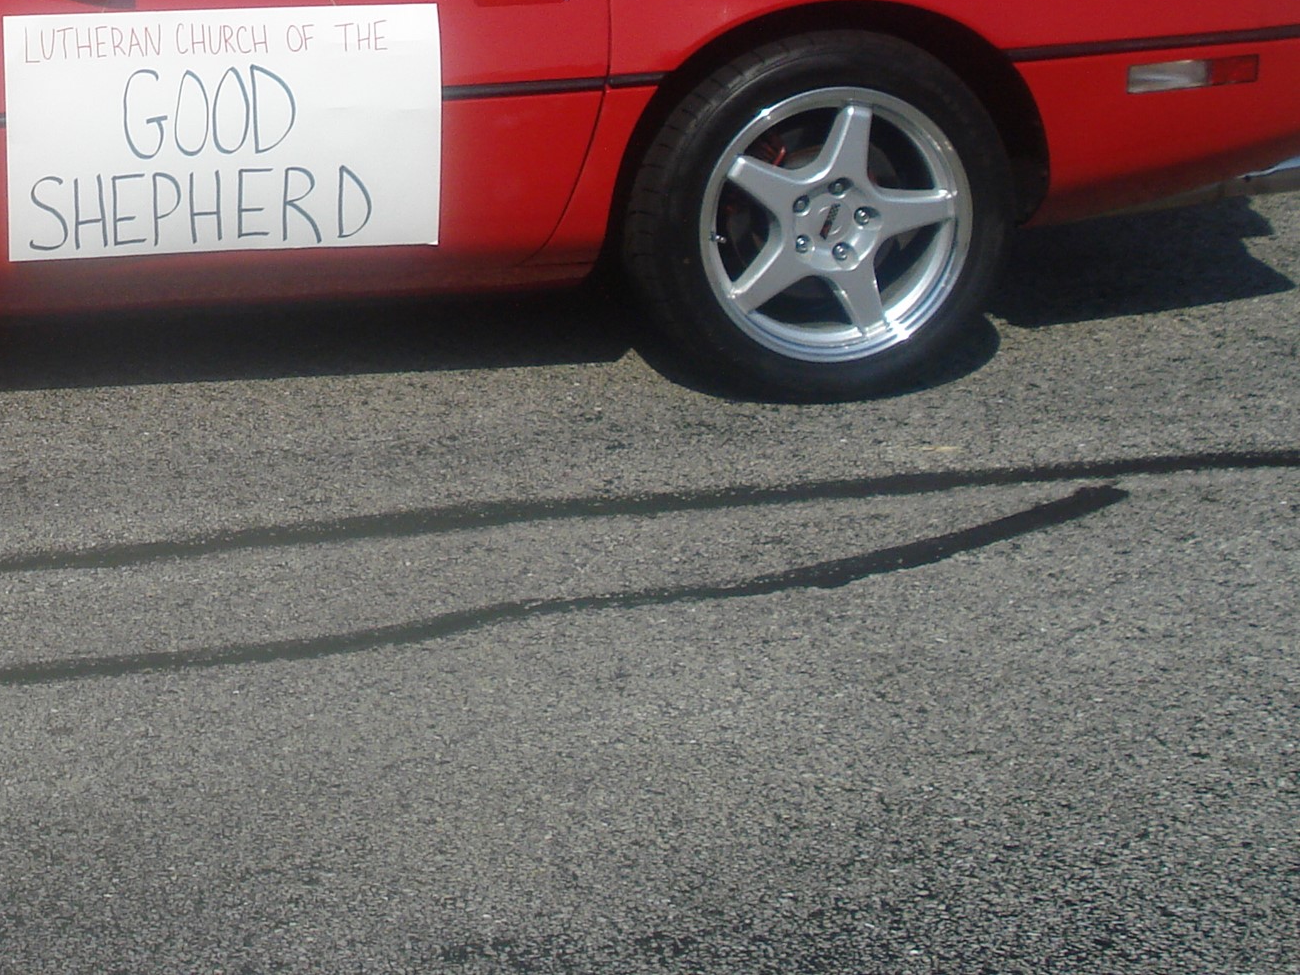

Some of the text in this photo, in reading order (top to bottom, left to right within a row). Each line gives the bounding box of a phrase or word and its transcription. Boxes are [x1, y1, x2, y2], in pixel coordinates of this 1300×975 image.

[24, 19, 389, 64] LUTHERAN CHURCH OF THE
[123, 64, 296, 160] GOOD
[28, 165, 373, 251] SHEPHERD
